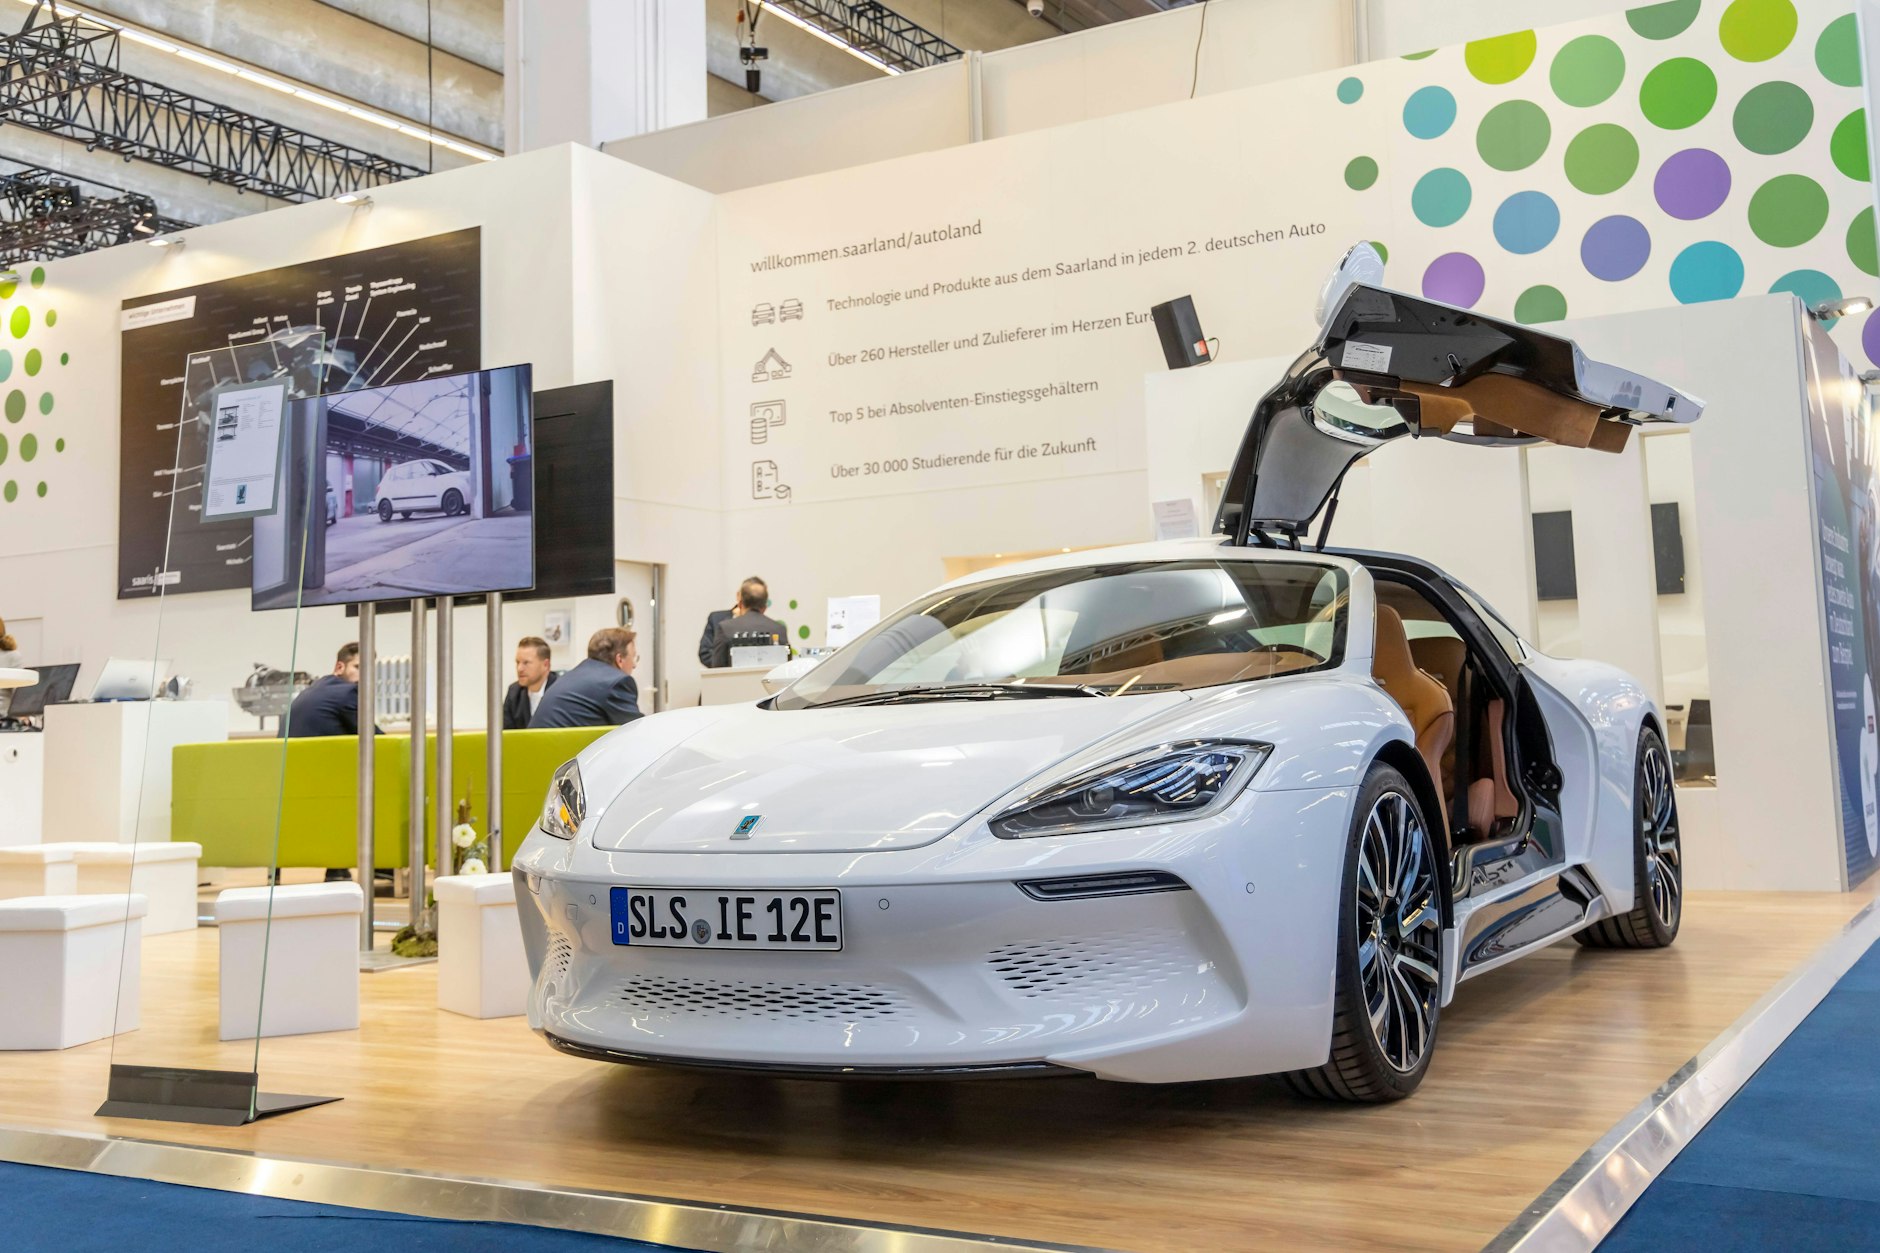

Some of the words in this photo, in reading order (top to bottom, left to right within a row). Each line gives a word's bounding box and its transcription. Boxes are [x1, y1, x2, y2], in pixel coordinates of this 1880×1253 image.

[750, 219, 982, 272] willkommen.saarland/autoland
[826, 288, 902, 312] Technologie
[904, 283, 930, 301] und
[932, 275, 992, 296] Produkte
[994, 272, 1019, 286] aus
[1021, 266, 1052, 282] dem
[1054, 252, 1118, 277] Saarland
[1120, 251, 1135, 266] in
[1137, 245, 1184, 267] jedem
[1186, 240, 1201, 256] 2.
[1204, 229, 1285, 253] deutschen
[1288, 222, 1327, 239] Auto
[827, 351, 858, 368] Über
[860, 347, 886, 364] 260
[887, 338, 951, 359] Hersteller
[952, 333, 980, 351] und
[981, 326, 1048, 347] Zulieferer
[1050, 322, 1069, 337] im
[1071, 316, 1122, 334] Herzen
[828, 410, 854, 425] Top
[855, 406, 865, 421] 5
[866, 405, 887, 420] bei
[888, 380, 1099, 416] Absolventen-Einstiegsgehältern
[830, 463, 861, 479] Über
[863, 457, 909, 476] 30.000
[911, 449, 992, 471] Studierende
[993, 446, 1014, 462] für
[1016, 444, 1039, 460] die
[1040, 436, 1097, 457] Zukunft
[617, 922, 625, 935] D
[630, 895, 688, 939] SLS
[717, 897, 757, 941] IE
[766, 897, 838, 943] 12E
